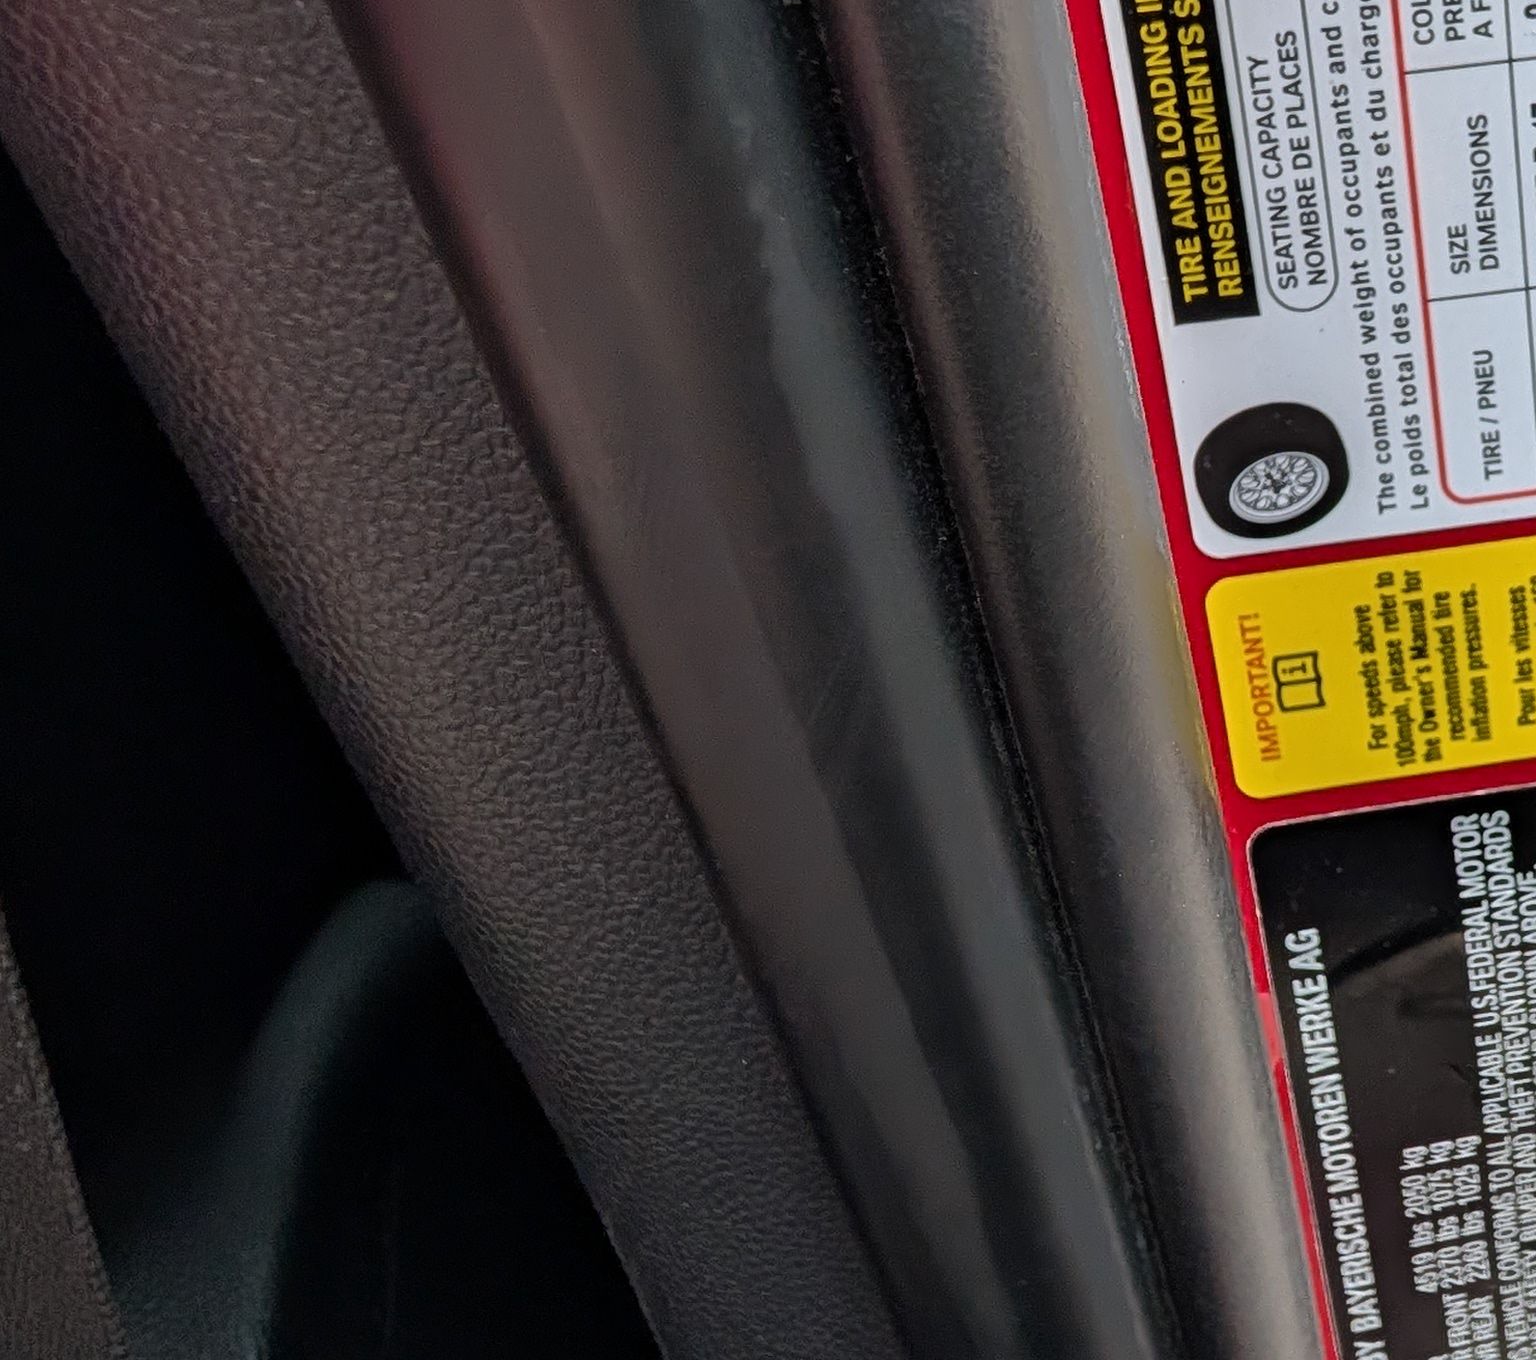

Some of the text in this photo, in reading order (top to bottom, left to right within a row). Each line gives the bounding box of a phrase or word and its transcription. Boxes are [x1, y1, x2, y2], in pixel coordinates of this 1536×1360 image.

[1320, 25, 1347, 75] and
[1472, 19, 1493, 38] A
[1139, 20, 1187, 159] LOADING
[1365, 89, 1387, 122] du
[1177, 23, 1244, 297] RENSEIGNEMENTS
[1246, 56, 1299, 290] SEATING CAPACITY
[1275, 30, 1328, 286] NOMBRE DE PLACES
[1330, 83, 1363, 218] occupants
[1369, 130, 1391, 157] et
[1164, 165, 1199, 230] AND
[1466, 114, 1500, 271] DIMENSIONS
[1343, 227, 1367, 252] of
[1375, 165, 1406, 295] occupants
[1447, 223, 1471, 275] SIZE
[1175, 235, 1209, 303] TIRE
[1349, 259, 1377, 345] weight
[1390, 302, 1412, 345] des
[1359, 352, 1392, 465] combined
[1393, 352, 1418, 407] total
[1401, 414, 1430, 477] poids
[1472, 349, 1503, 481] TIRE / PNEU
[1377, 472, 1397, 515] The
[1410, 483, 1430, 510] Le
[1374, 571, 1395, 589] to
[1376, 593, 1400, 634] refer
[1238, 613, 1282, 762] IMPORTANT!
[1353, 604, 1390, 751] For speeds above
[1385, 638, 1412, 694] please
[1450, 813, 1488, 899] MOTOR
[1284, 927, 1325, 971] AG
[1291, 974, 1340, 1074] WERKE
[1474, 1032, 1511, 1134] APPLICABLE
[1308, 1073, 1360, 1194] MOTOREN
[1398, 1145, 1431, 1171] kg
[1485, 1135, 1513, 1166] ALL
[1400, 1173, 1433, 1218] 2050
[1487, 1168, 1516, 1193] TO
[1328, 1192, 1383, 1333] BAYERISCHE
[1408, 1221, 1436, 1248] lbs
[1489, 1191, 1524, 1281] CONFORMS
[1499, 1280, 1531, 1349] VEHICLE
